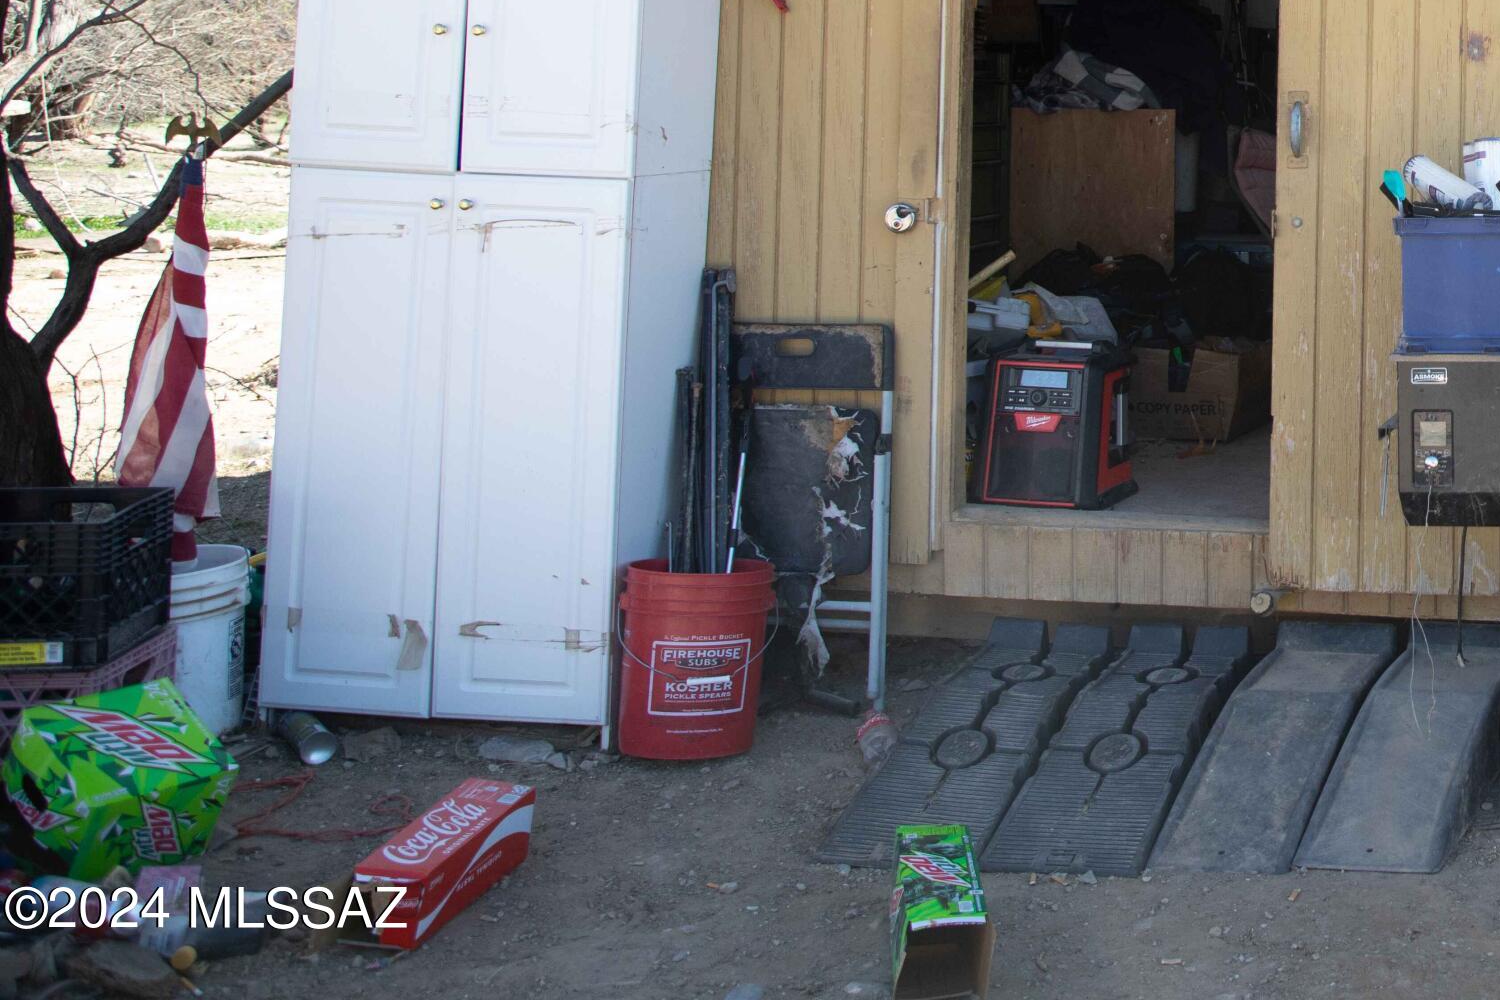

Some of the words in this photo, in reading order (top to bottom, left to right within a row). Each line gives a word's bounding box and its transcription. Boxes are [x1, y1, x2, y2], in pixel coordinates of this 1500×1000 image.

[1136, 401, 1169, 414] COPY
[1174, 403, 1217, 416] PAPER
[663, 647, 741, 662] FIREHOUSE
[687, 658, 718, 667] SUBS
[665, 681, 733, 692] KOSHER
[698, 691, 731, 699] SPEARS
